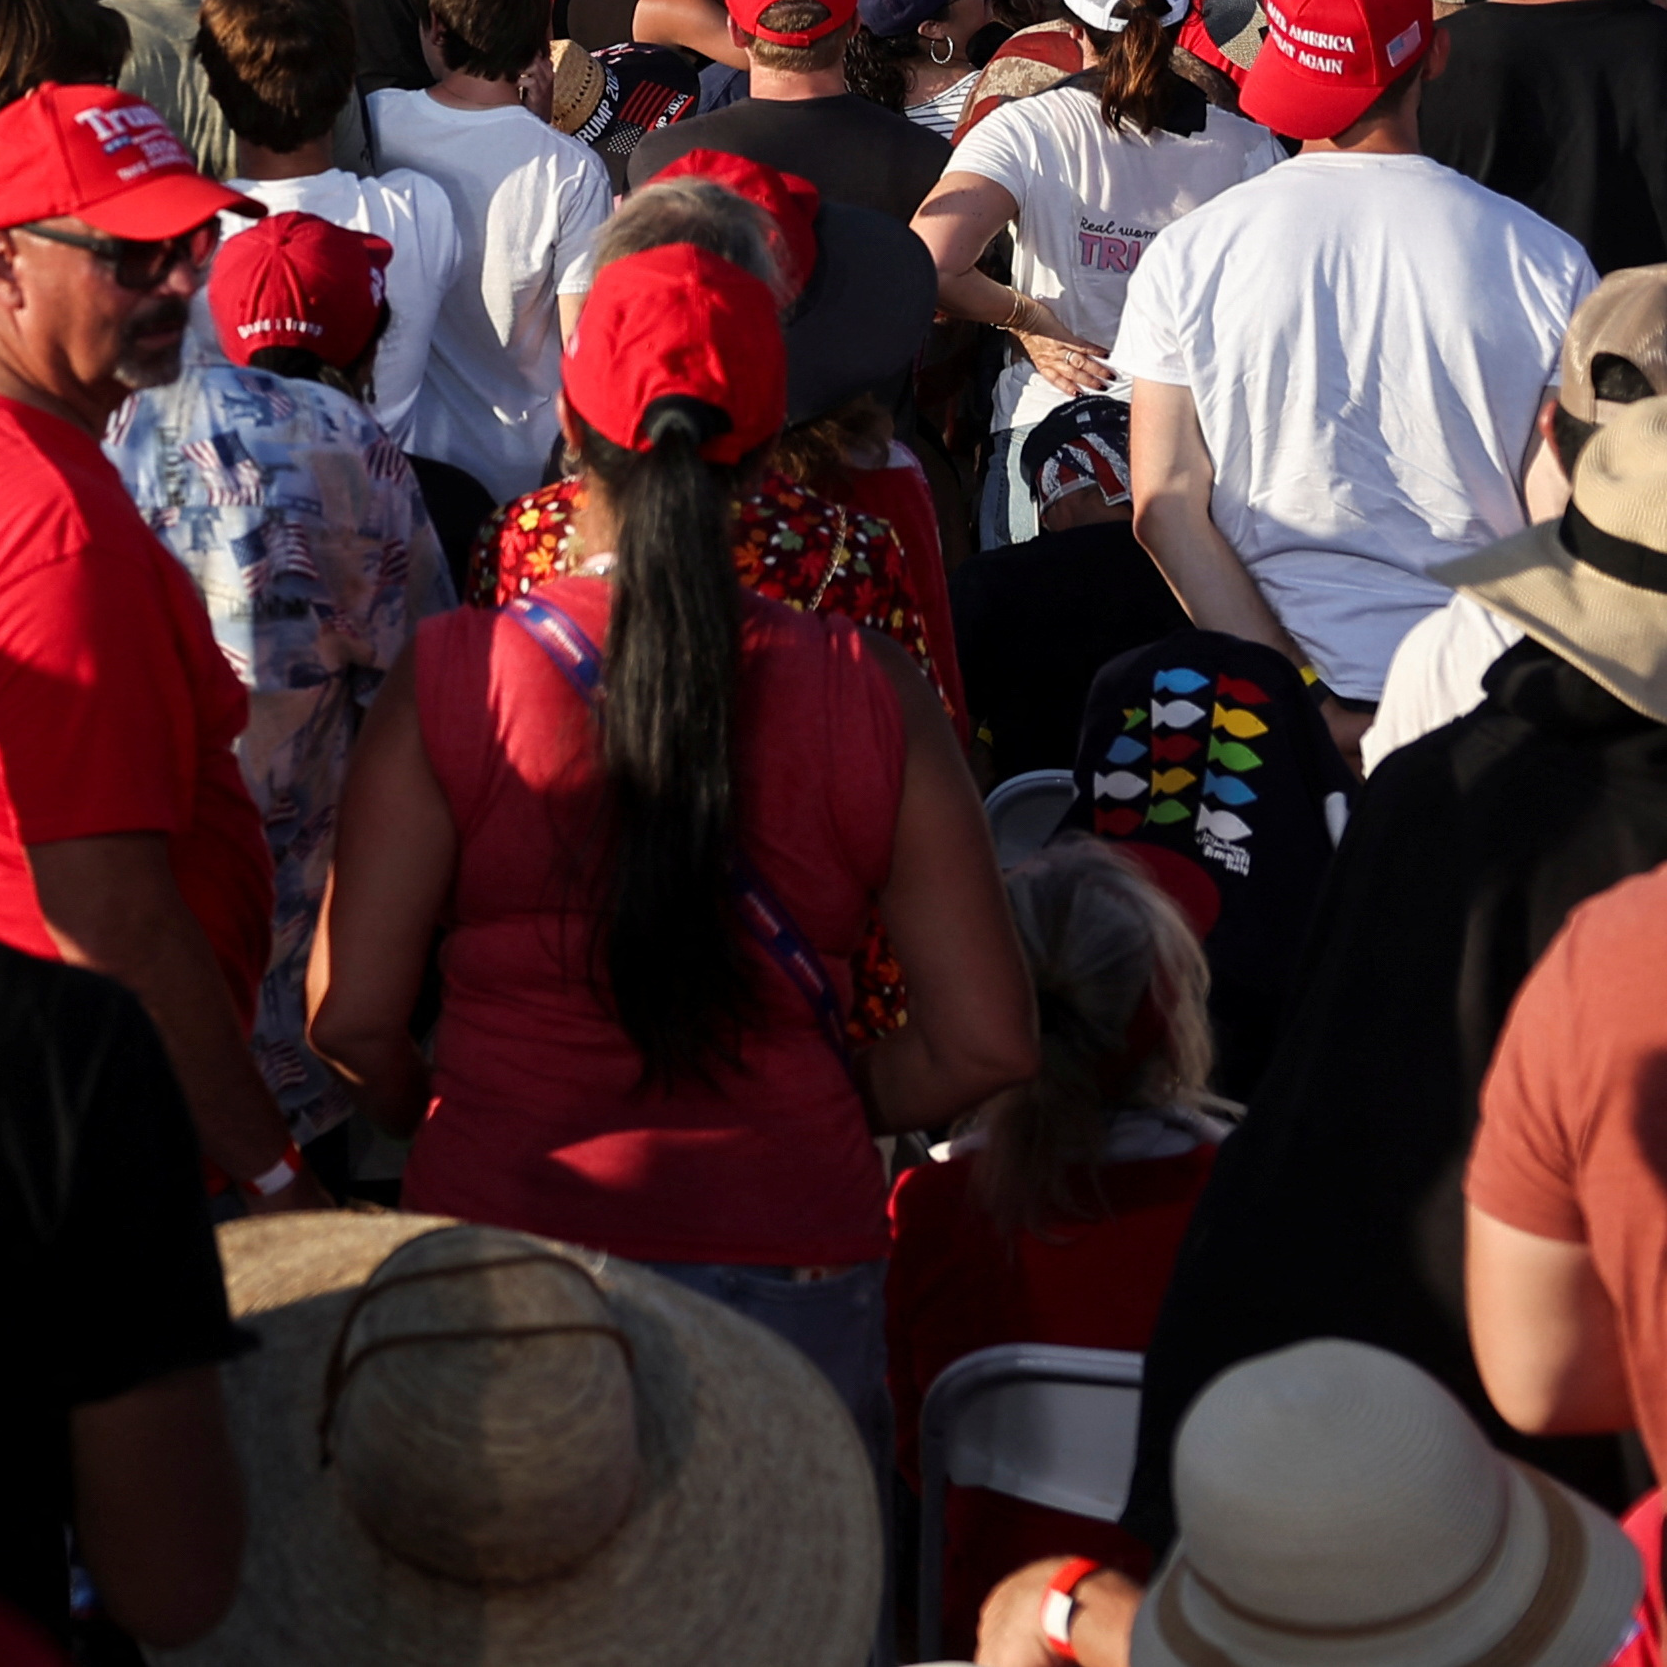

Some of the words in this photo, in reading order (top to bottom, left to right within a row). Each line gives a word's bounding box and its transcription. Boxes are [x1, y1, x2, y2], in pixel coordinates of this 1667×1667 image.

[1288, 22, 1356, 54] AMERICA
[1298, 50, 1344, 74] AGAIN
[1079, 216, 1116, 234] Real
